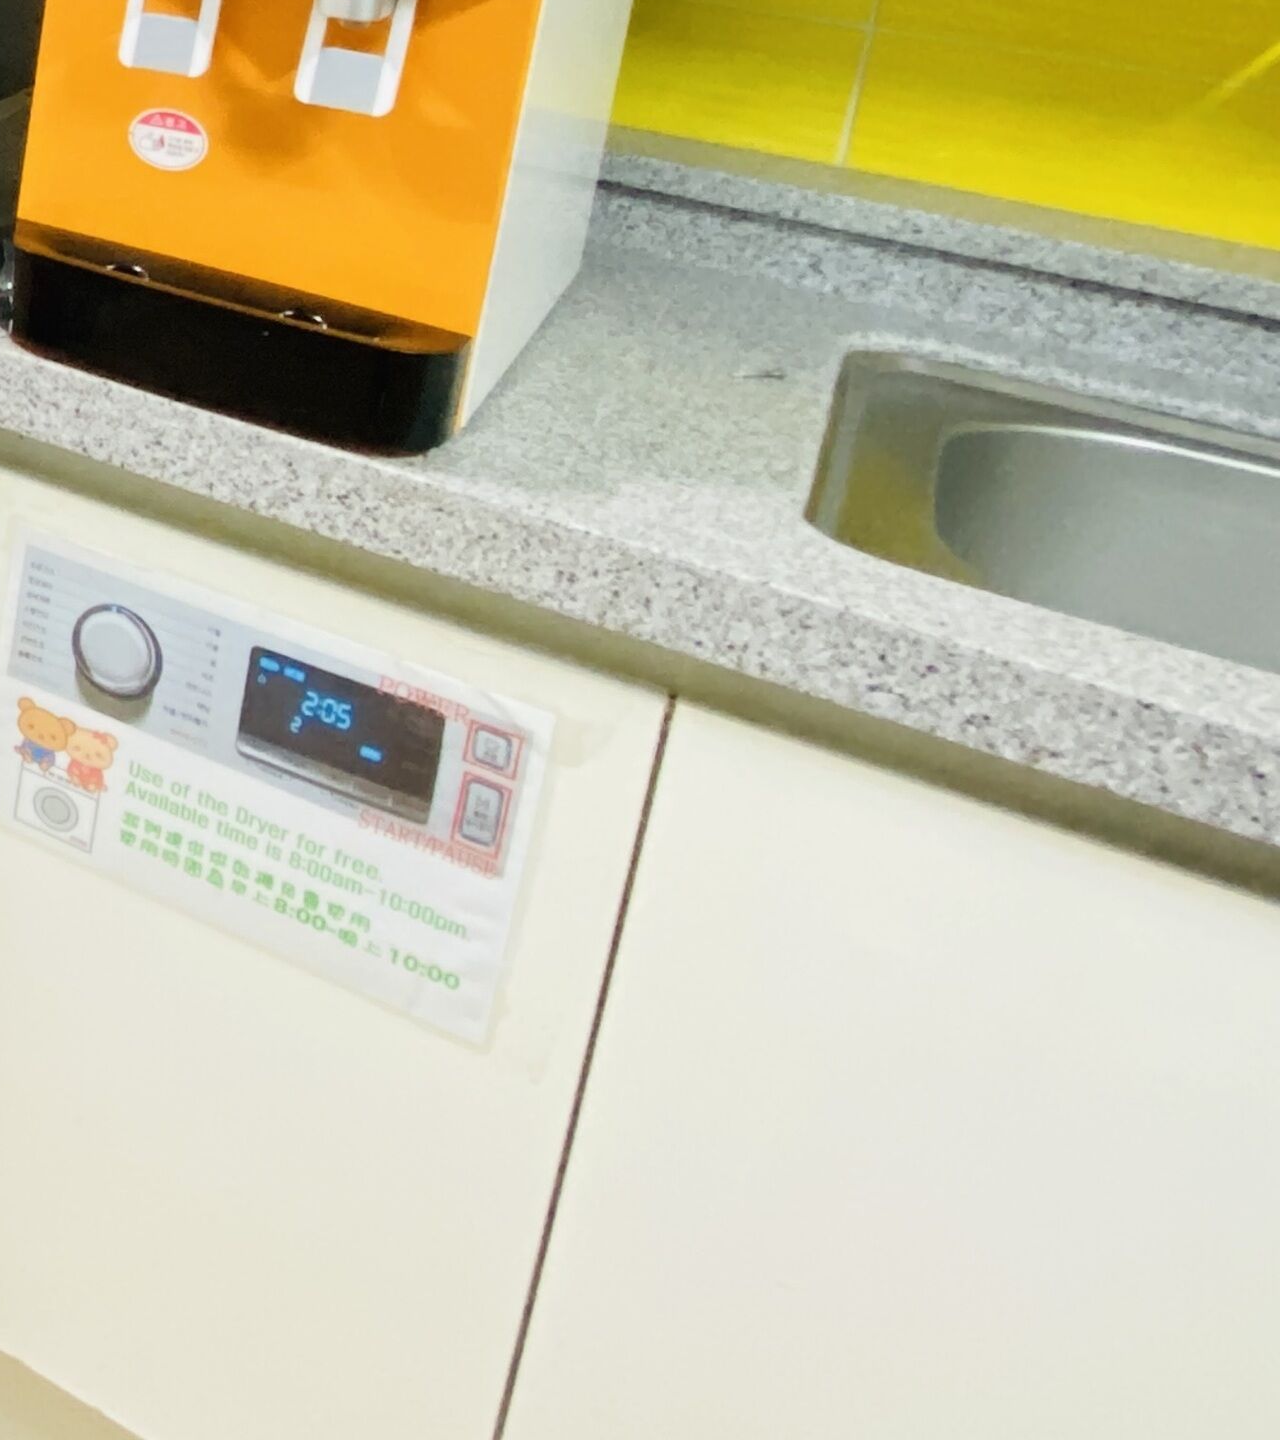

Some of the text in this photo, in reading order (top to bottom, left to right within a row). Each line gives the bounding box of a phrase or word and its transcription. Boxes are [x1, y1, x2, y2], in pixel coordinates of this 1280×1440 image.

[300, 691, 352, 730] 2:05
[125, 781, 209, 830] Available
[216, 820, 258, 851] time
[266, 841, 283, 861] is
[129, 760, 382, 882] Use of the Dryer for free.
